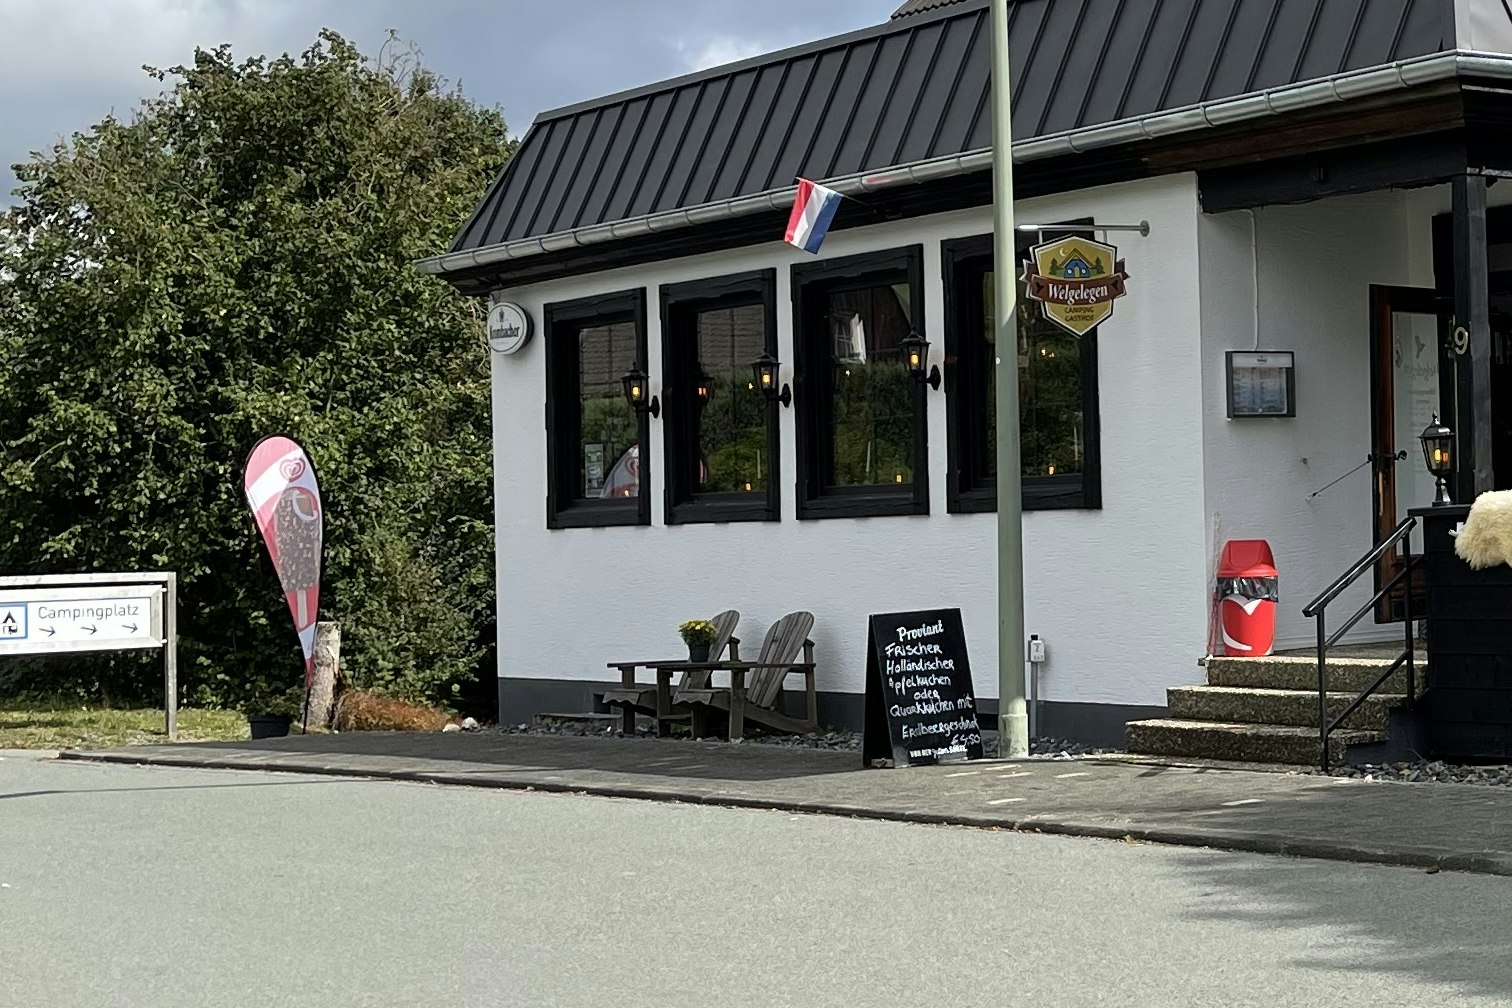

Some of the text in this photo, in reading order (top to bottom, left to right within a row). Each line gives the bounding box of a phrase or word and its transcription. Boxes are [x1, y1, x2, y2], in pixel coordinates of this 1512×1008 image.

[1048, 283, 1109, 306] Welgelegen
[1454, 326, 1469, 355] 9
[37, 603, 140, 622] Campingplatz
[896, 619, 944, 642] Proviant
